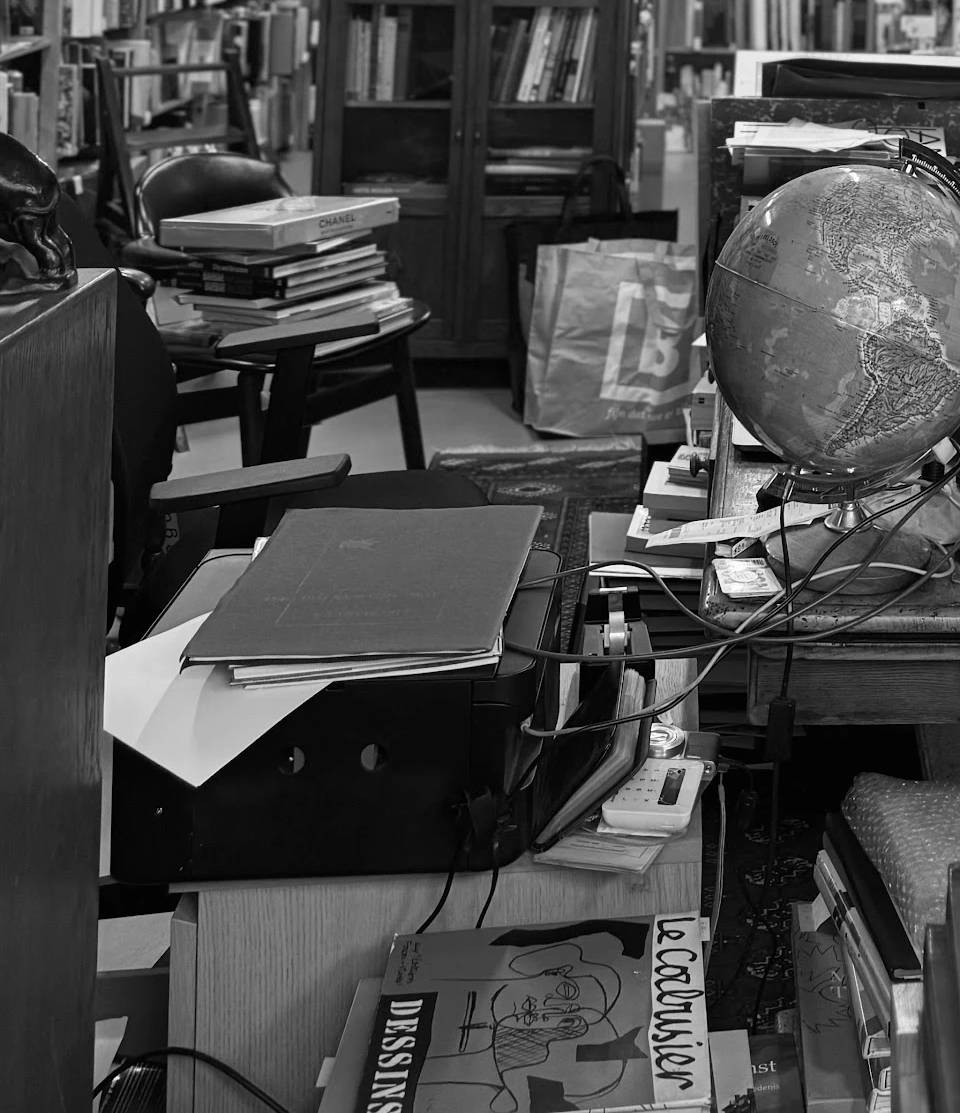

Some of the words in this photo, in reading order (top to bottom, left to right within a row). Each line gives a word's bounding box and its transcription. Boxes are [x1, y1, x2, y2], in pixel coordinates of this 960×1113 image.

[319, 213, 356, 228] CHANEL
[651, 948, 705, 1091] Corbusier
[366, 998, 424, 1113] DESSINS
[751, 1059, 777, 1074] nst
